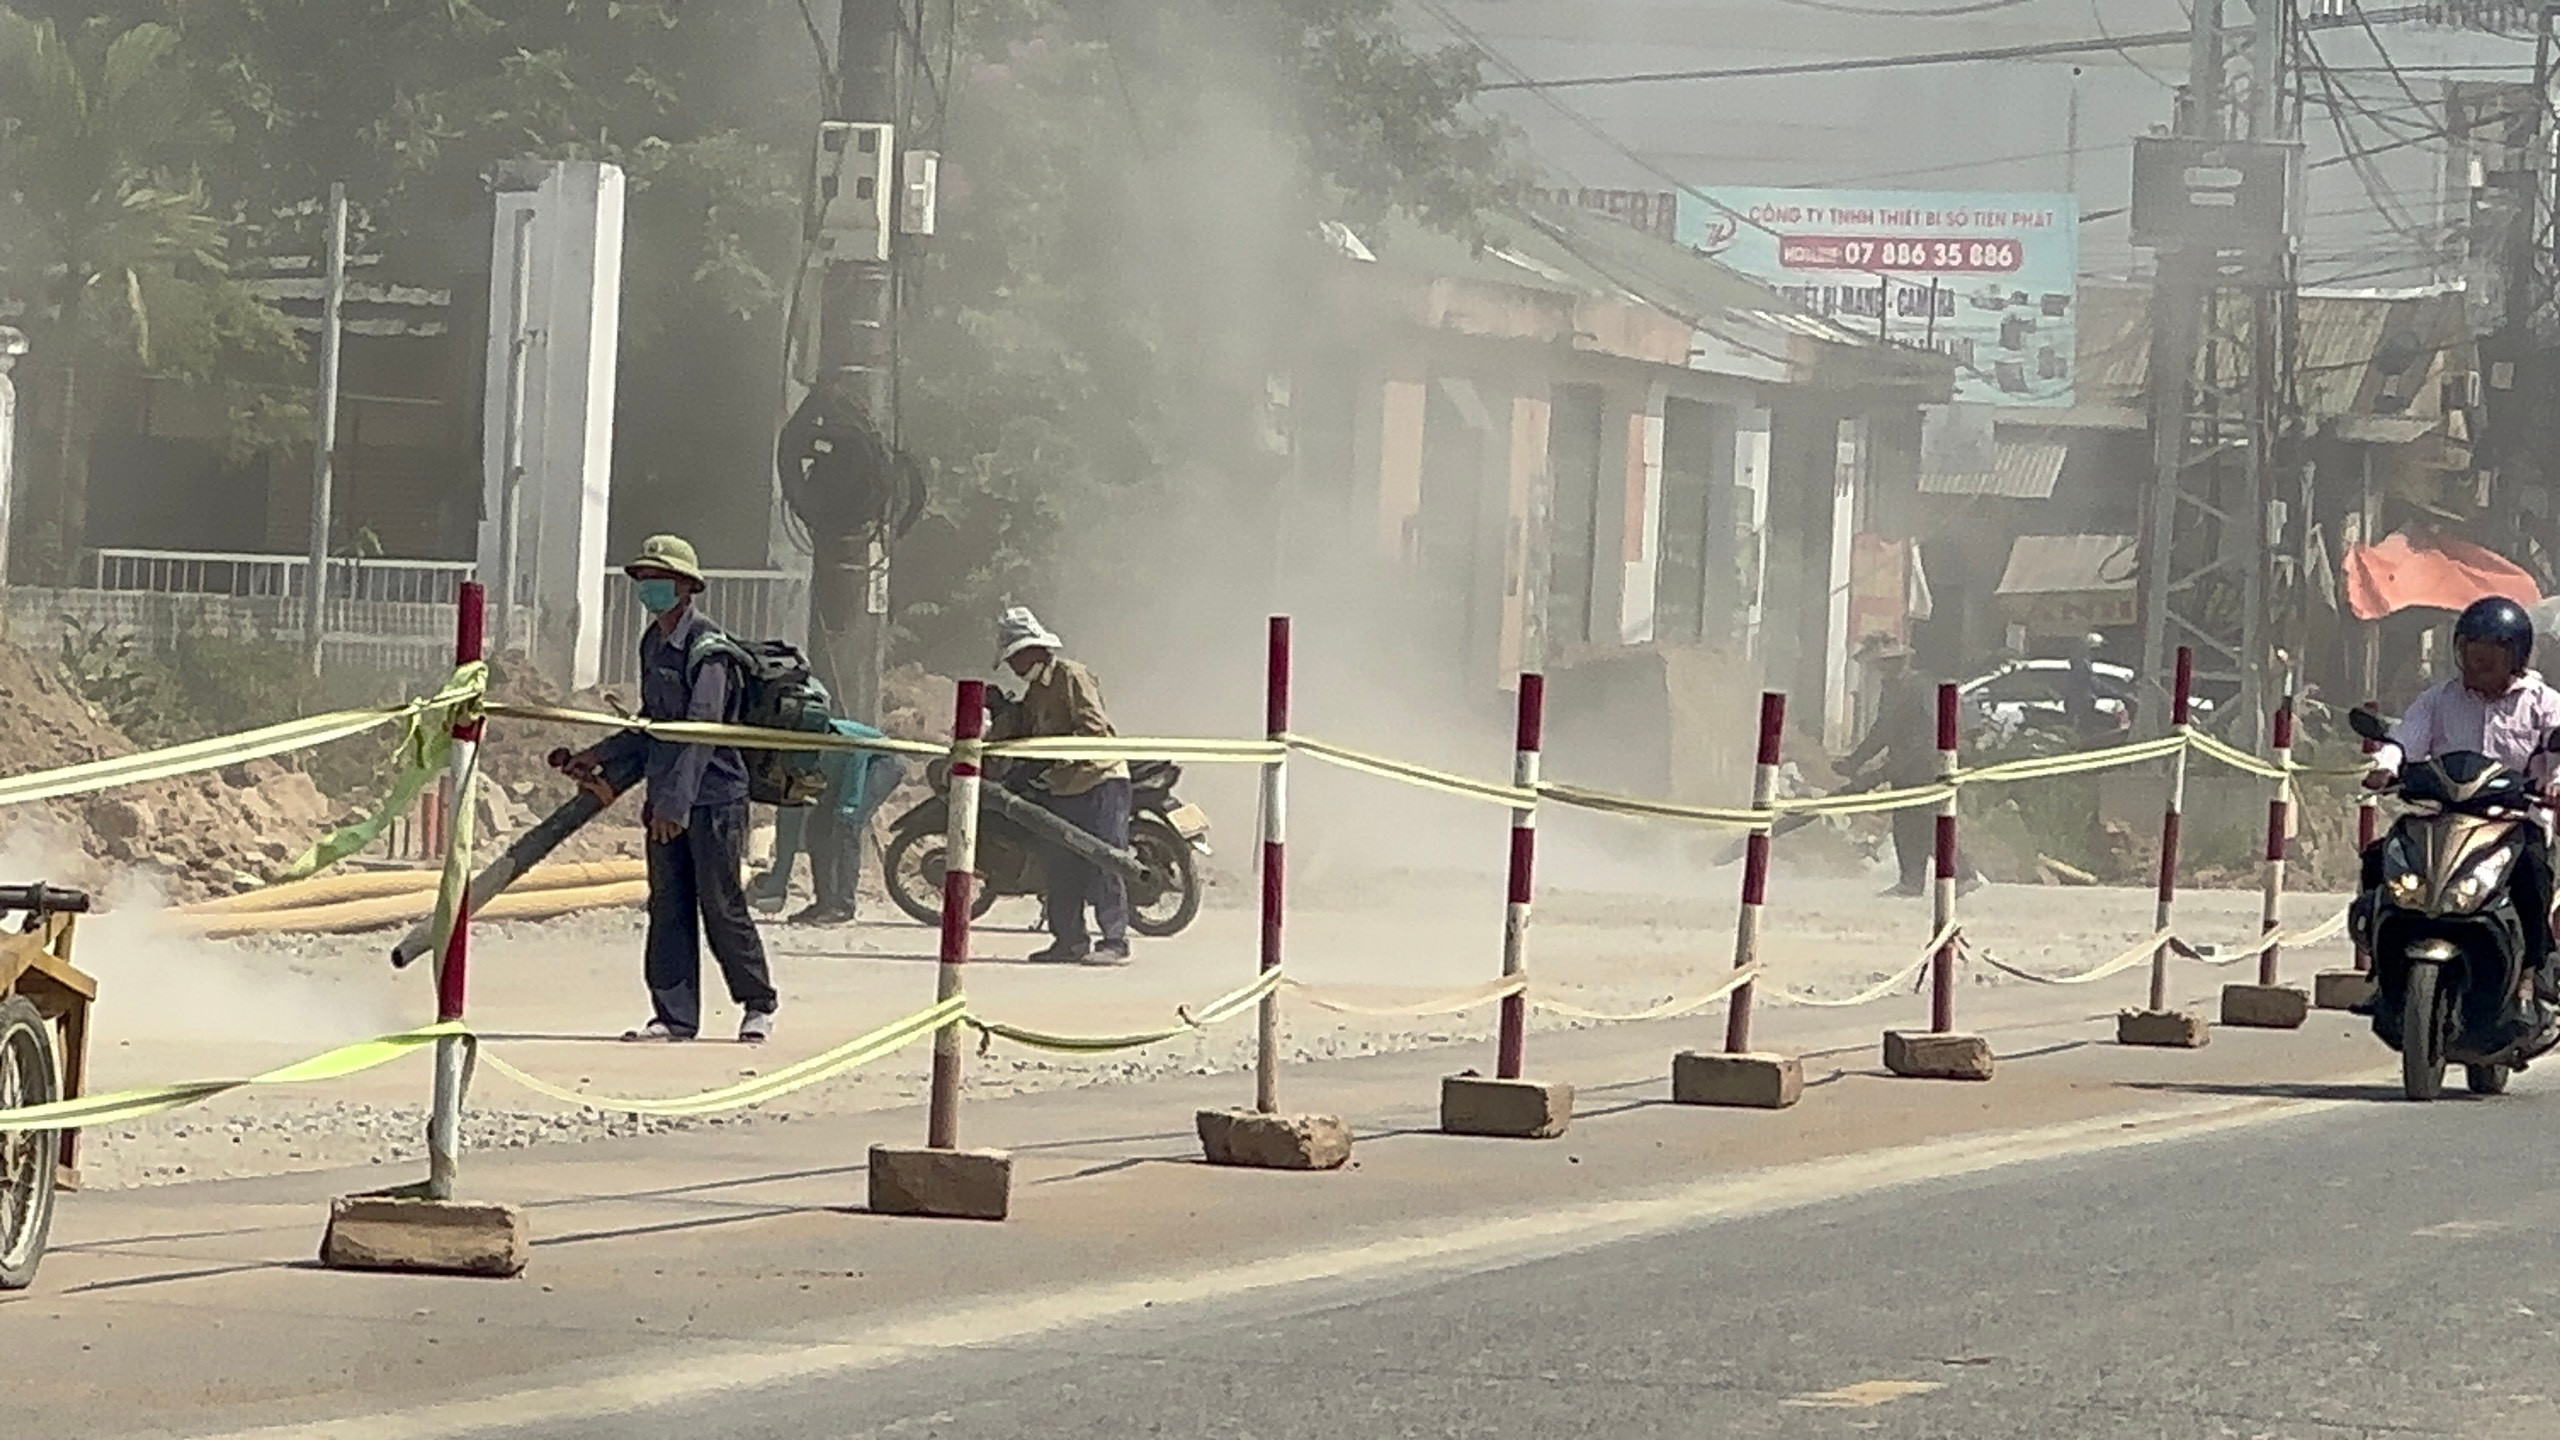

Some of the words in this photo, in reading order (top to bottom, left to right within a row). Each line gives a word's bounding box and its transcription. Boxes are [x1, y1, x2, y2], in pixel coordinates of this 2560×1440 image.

[1749, 202, 1802, 223] CÔNG
[1806, 207, 1823, 222] TY
[1829, 207, 1874, 225] TNHH
[1844, 241, 1874, 264] 07
[1882, 242, 1926, 265] 886
[1934, 242, 1962, 266] 35
[1969, 242, 2013, 266] 886
